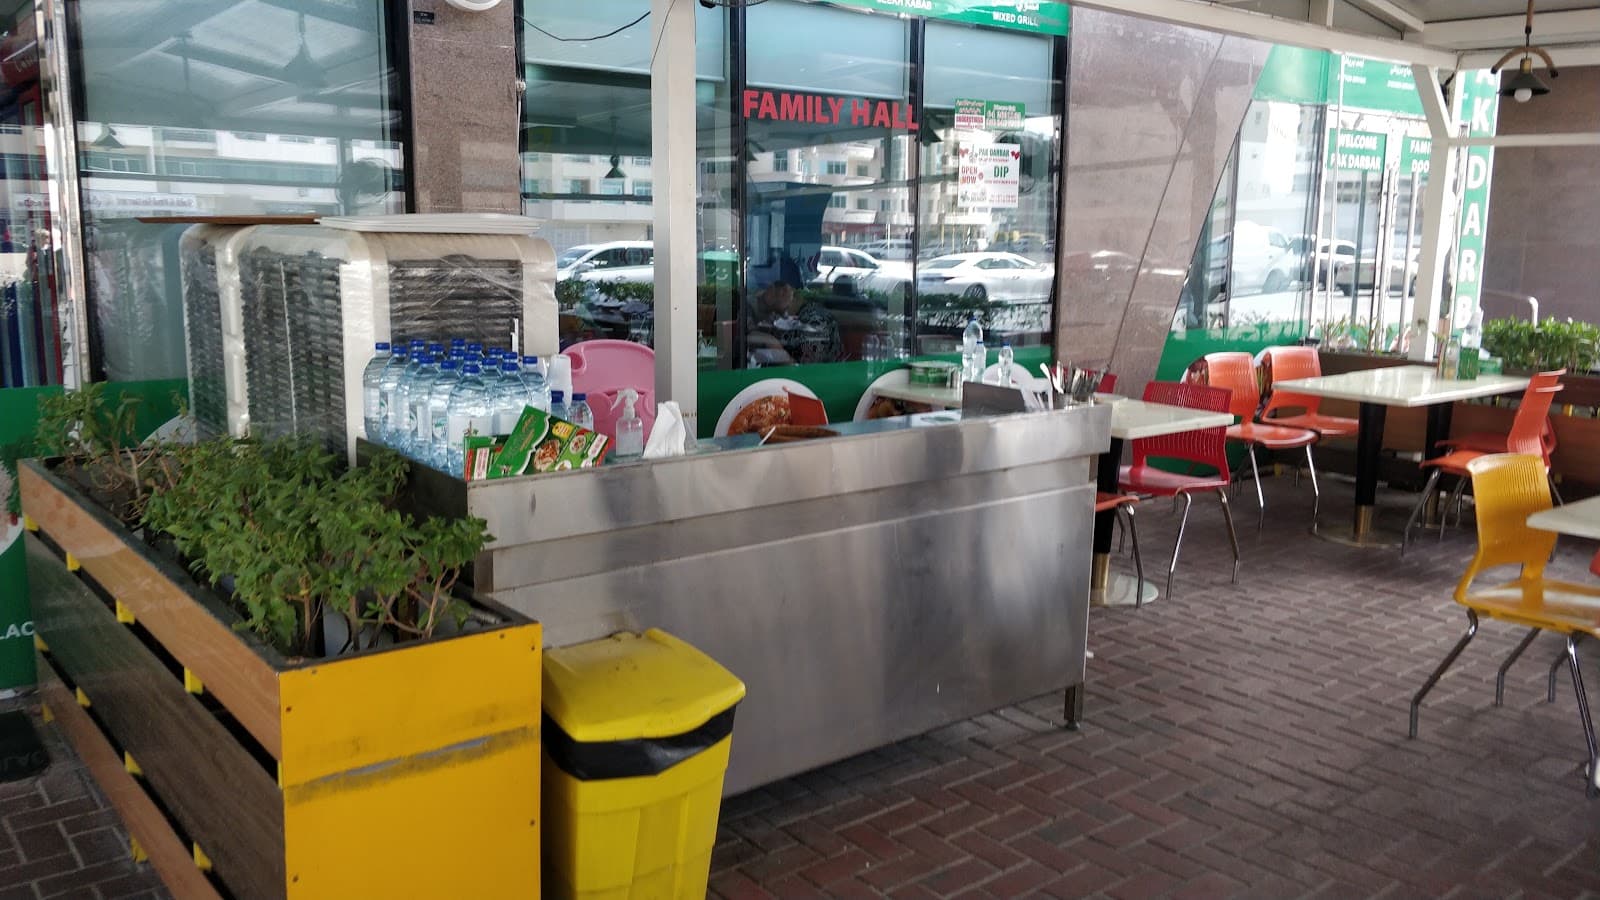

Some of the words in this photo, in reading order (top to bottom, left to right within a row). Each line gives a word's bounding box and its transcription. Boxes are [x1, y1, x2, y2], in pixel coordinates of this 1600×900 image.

[992, 11, 1016, 23] MIXED
[1017, 14, 1040, 27] GRILL
[743, 90, 844, 125] FAMILY
[852, 99, 919, 131] HALL
[1340, 133, 1378, 151] WELCOME
[961, 165, 978, 175] OPEN
[1347, 153, 1382, 171] DARBAR
[993, 165, 1010, 178] DIP
[960, 175, 977, 185] NOW
